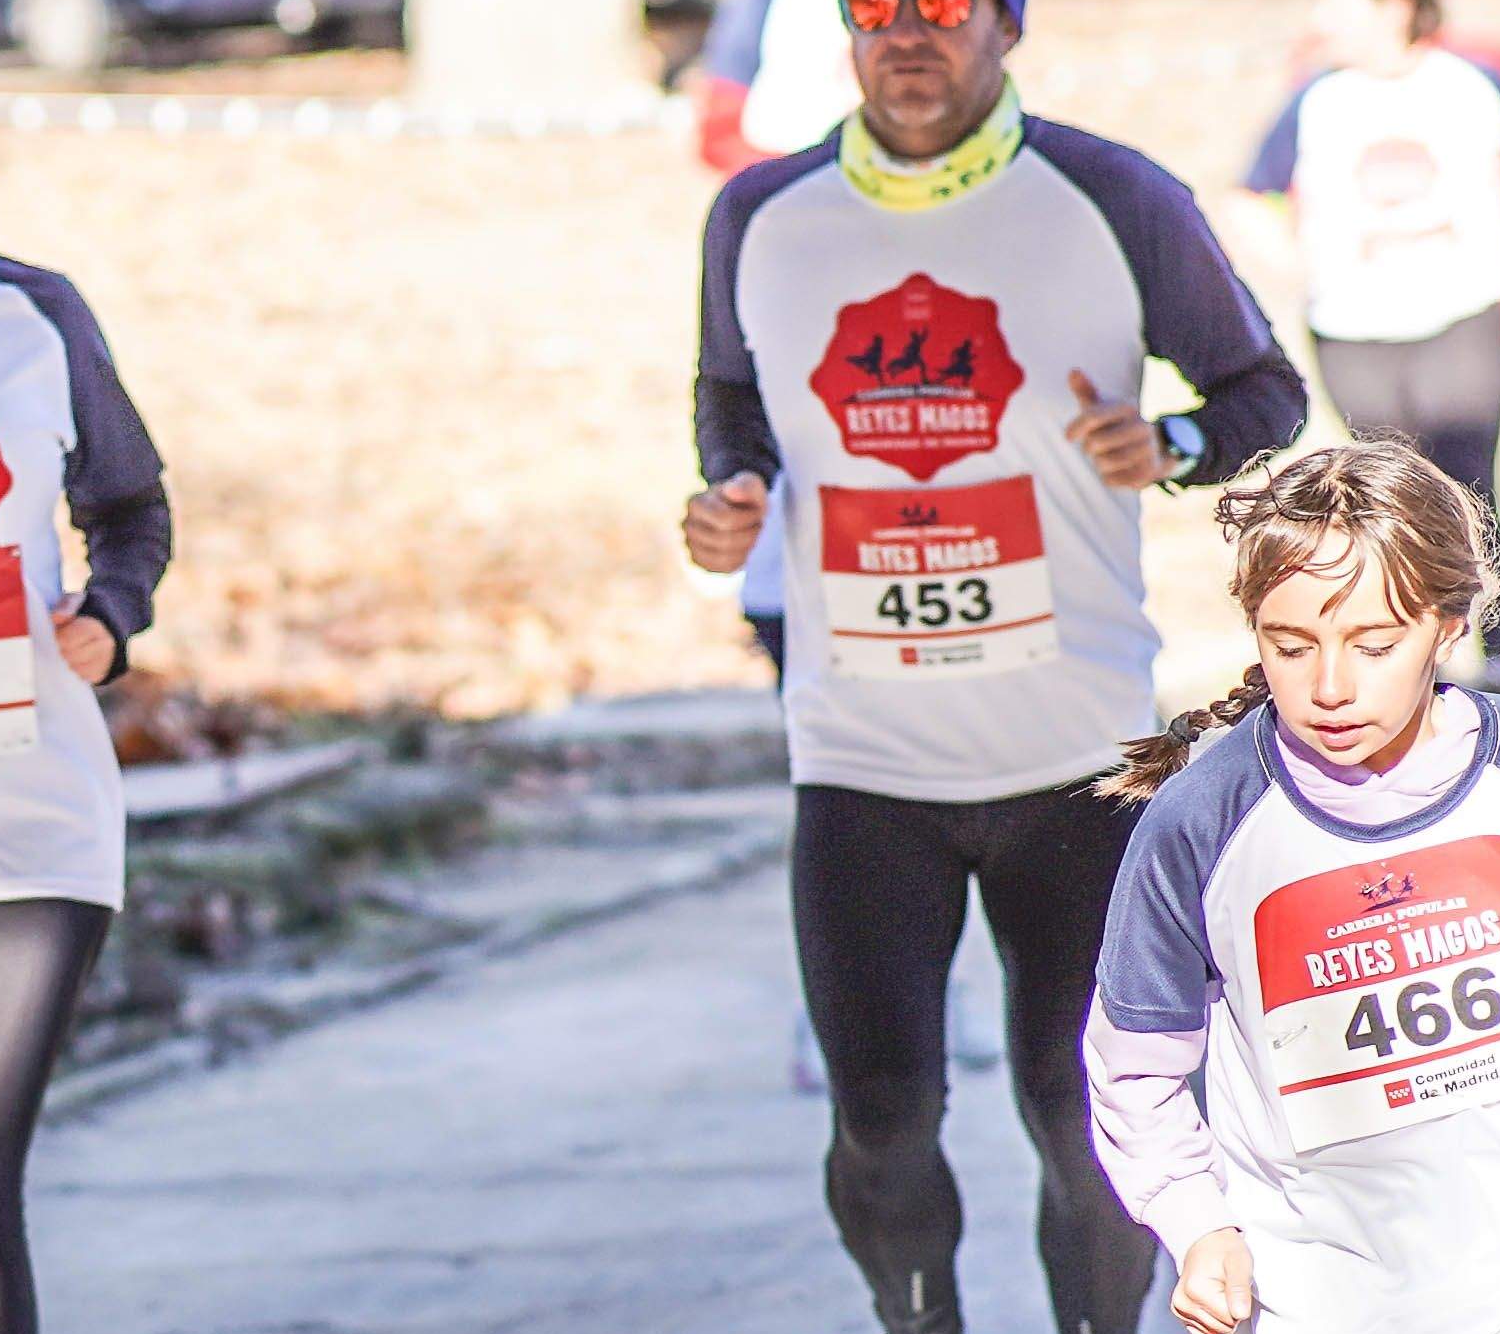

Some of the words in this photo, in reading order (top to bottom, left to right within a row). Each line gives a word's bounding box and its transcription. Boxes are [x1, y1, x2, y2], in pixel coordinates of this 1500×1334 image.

[846, 404, 911, 434] REYES
[918, 403, 990, 433] MAGOS
[857, 541, 919, 572] REYES
[923, 536, 999, 571] MAGOS
[878, 578, 993, 627] 453
[1326, 912, 1395, 939] CARRERA
[1396, 897, 1468, 921] POPULAR
[1304, 938, 1396, 988] REYES
[1415, 1053, 1496, 1085] Comunidad
[1419, 1088, 1439, 1100] de
[1444, 1068, 1499, 1094] Madrid
